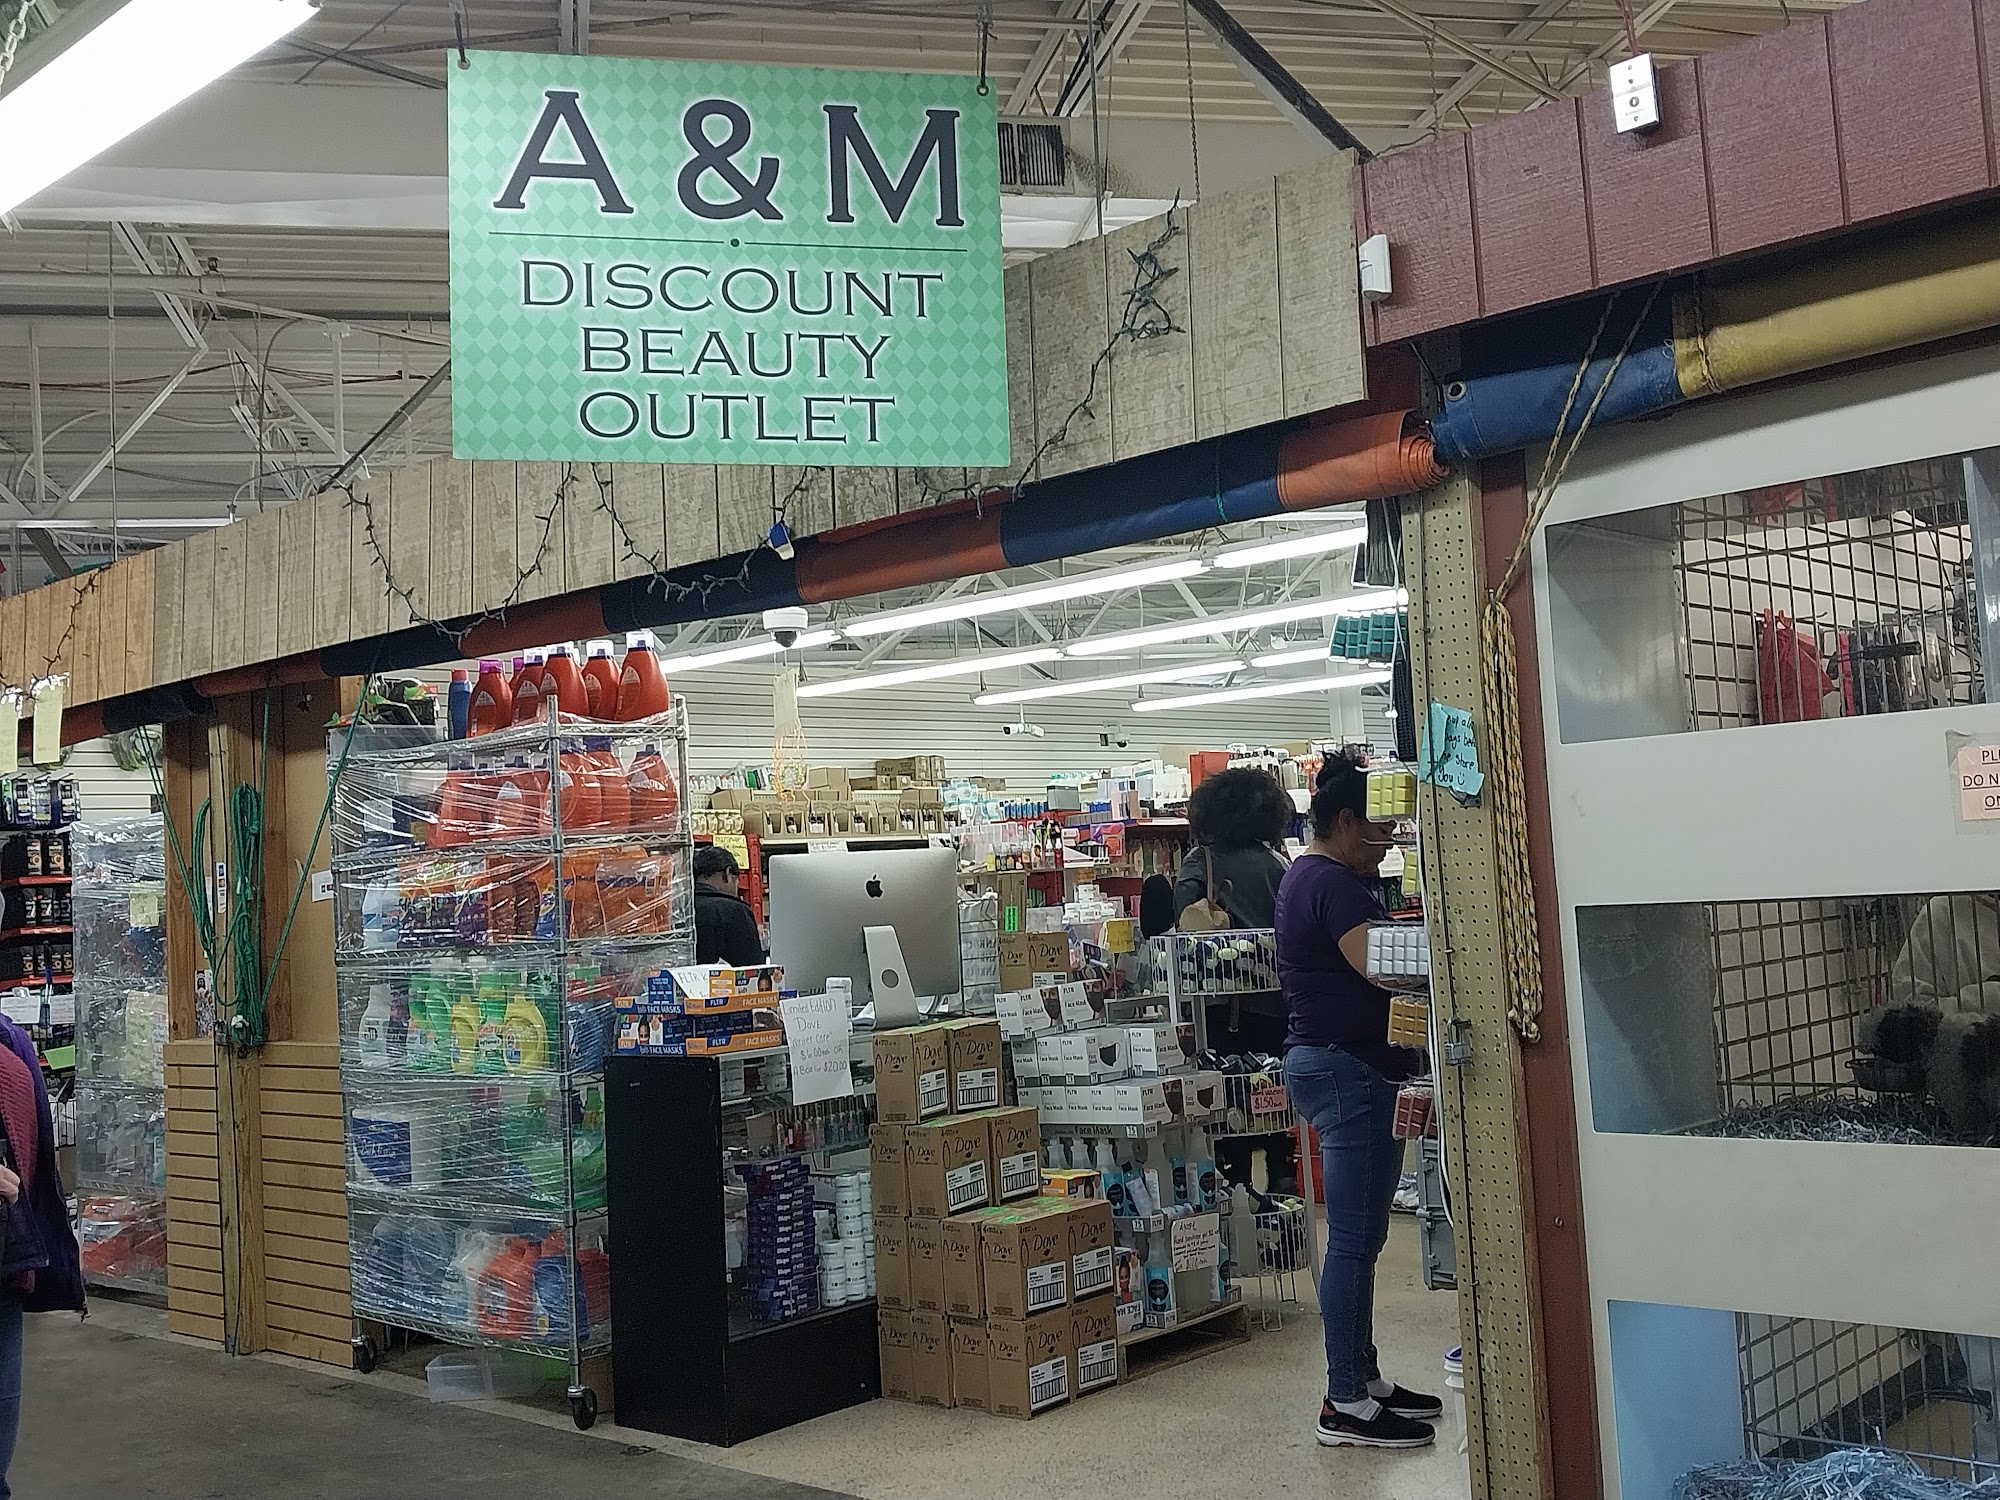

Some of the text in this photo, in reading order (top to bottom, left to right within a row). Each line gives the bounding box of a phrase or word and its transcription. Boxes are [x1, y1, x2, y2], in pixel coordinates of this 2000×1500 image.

[493, 90, 964, 226] A & M
[520, 259, 943, 317] DISCOUNT
[582, 327, 891, 379] BEAUTY
[579, 391, 896, 443] OUTLET
[1456, 752, 1475, 770] store
[1982, 750, 2000, 762] PL
[1963, 774, 1984, 787] DO
[1007, 951, 1023, 960] Dove
[1040, 943, 1063, 957] Dove
[743, 998, 757, 1006] FACE
[757, 996, 778, 1004] MASKS
[647, 1005, 660, 1014] FACE
[661, 1005, 681, 1013] MASKS
[783, 1002, 809, 1015] Limited
[712, 1038, 726, 1046] FLTR
[745, 1037, 759, 1045] FACE
[760, 1034, 780, 1043] MASKS
[649, 1046, 661, 1054] FACE
[662, 1045, 683, 1054] MASKS
[923, 1045, 942, 1061] Dove
[966, 1039, 993, 1055] Dove
[884, 1054, 907, 1064] Dove
[1008, 1127, 1032, 1143] Dove
[1075, 1126, 1091, 1135] Face
[1092, 1126, 1112, 1135] Mask
[880, 1146, 898, 1155] Dove
[917, 1146, 935, 1156] Dove
[954, 1137, 981, 1153] Dove
[1080, 1221, 1106, 1239] Dove
[882, 1235, 902, 1247] Dove
[917, 1239, 937, 1250] Dove
[1033, 1233, 1059, 1251] Dove
[950, 1242, 970, 1253] Dove
[993, 1243, 1013, 1254] Dove
[1085, 1315, 1110, 1334] Dove
[889, 1327, 908, 1339] Dove
[920, 1332, 940, 1345] Dove
[963, 1335, 982, 1346] Dove
[1038, 1330, 1063, 1349] Dove
[999, 1341, 1019, 1353] Dove
